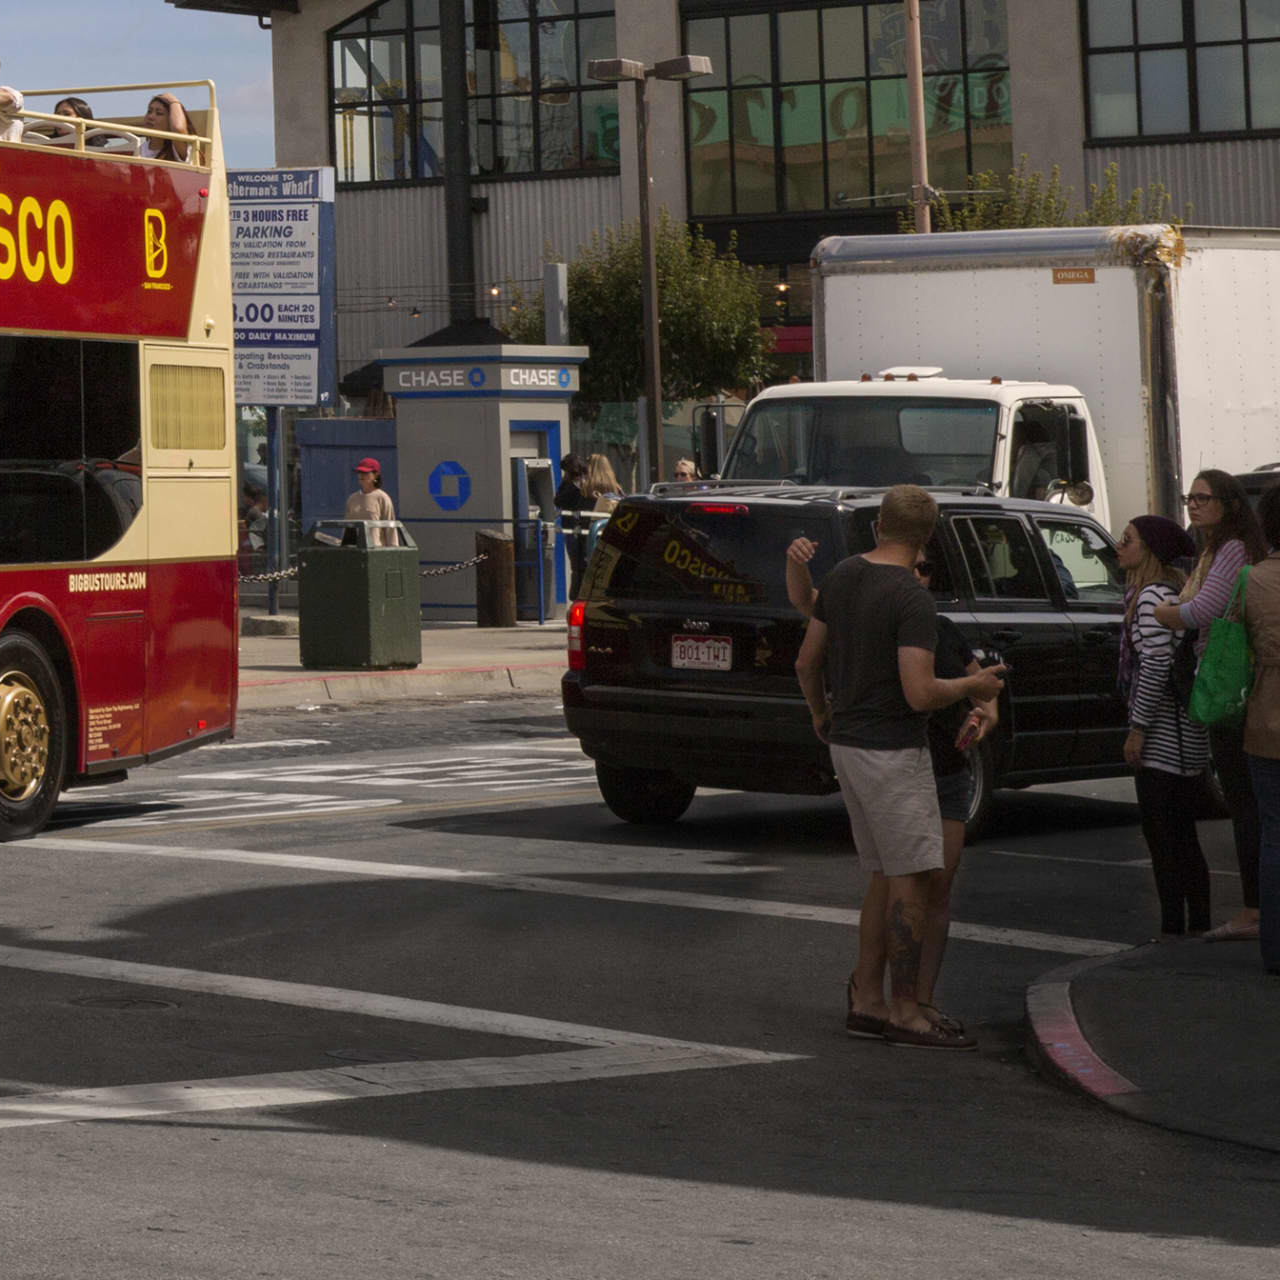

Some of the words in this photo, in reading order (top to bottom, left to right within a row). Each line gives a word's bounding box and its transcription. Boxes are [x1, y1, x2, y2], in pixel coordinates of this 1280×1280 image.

[237, 174, 279, 183] WELCOME
[281, 173, 314, 196] Wharf
[243, 209, 250, 223] 3
[251, 209, 284, 222] HOURS
[286, 209, 309, 222] FREE
[236, 225, 294, 240] PARKING
[243, 240, 286, 249] VALIDATION
[286, 240, 307, 248] FROM
[234, 271, 250, 279] FREE
[253, 271, 270, 279] WITH
[273, 271, 314, 279] VALIDATION
[277, 304, 300, 313] EACH
[302, 304, 316, 313] 20
[277, 315, 316, 324] MINUTES
[248, 332, 272, 341] DAILY
[274, 332, 316, 341] MAXIMUM
[267, 351, 312, 361] Restaurants
[247, 362, 291, 370] Crabstands
[398, 369, 465, 387] CHASE
[510, 368, 558, 386] CHASE
[68, 571, 147, 593] BIGBUSTOURS.COM
